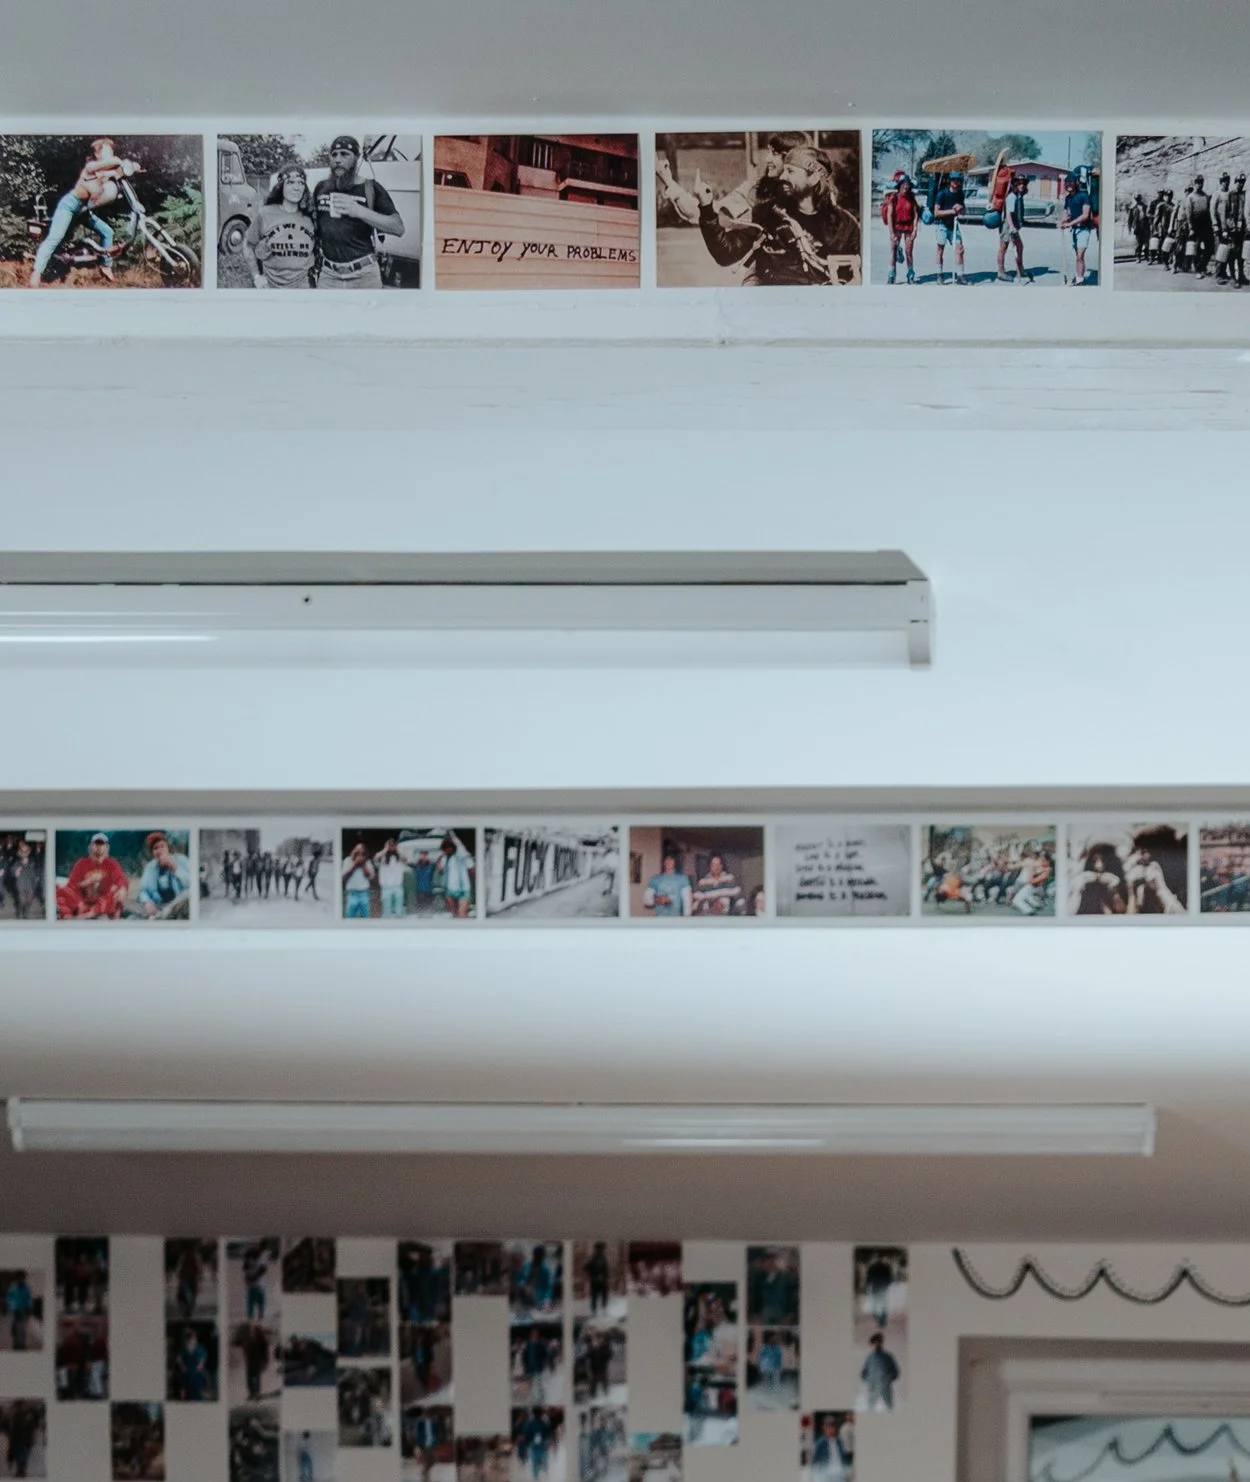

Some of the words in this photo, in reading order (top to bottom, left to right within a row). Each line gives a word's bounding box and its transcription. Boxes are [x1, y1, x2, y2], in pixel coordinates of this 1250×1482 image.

[441, 238, 513, 262] ENJOY
[517, 242, 559, 261] YOUR
[566, 245, 637, 262] PROBLEMS
